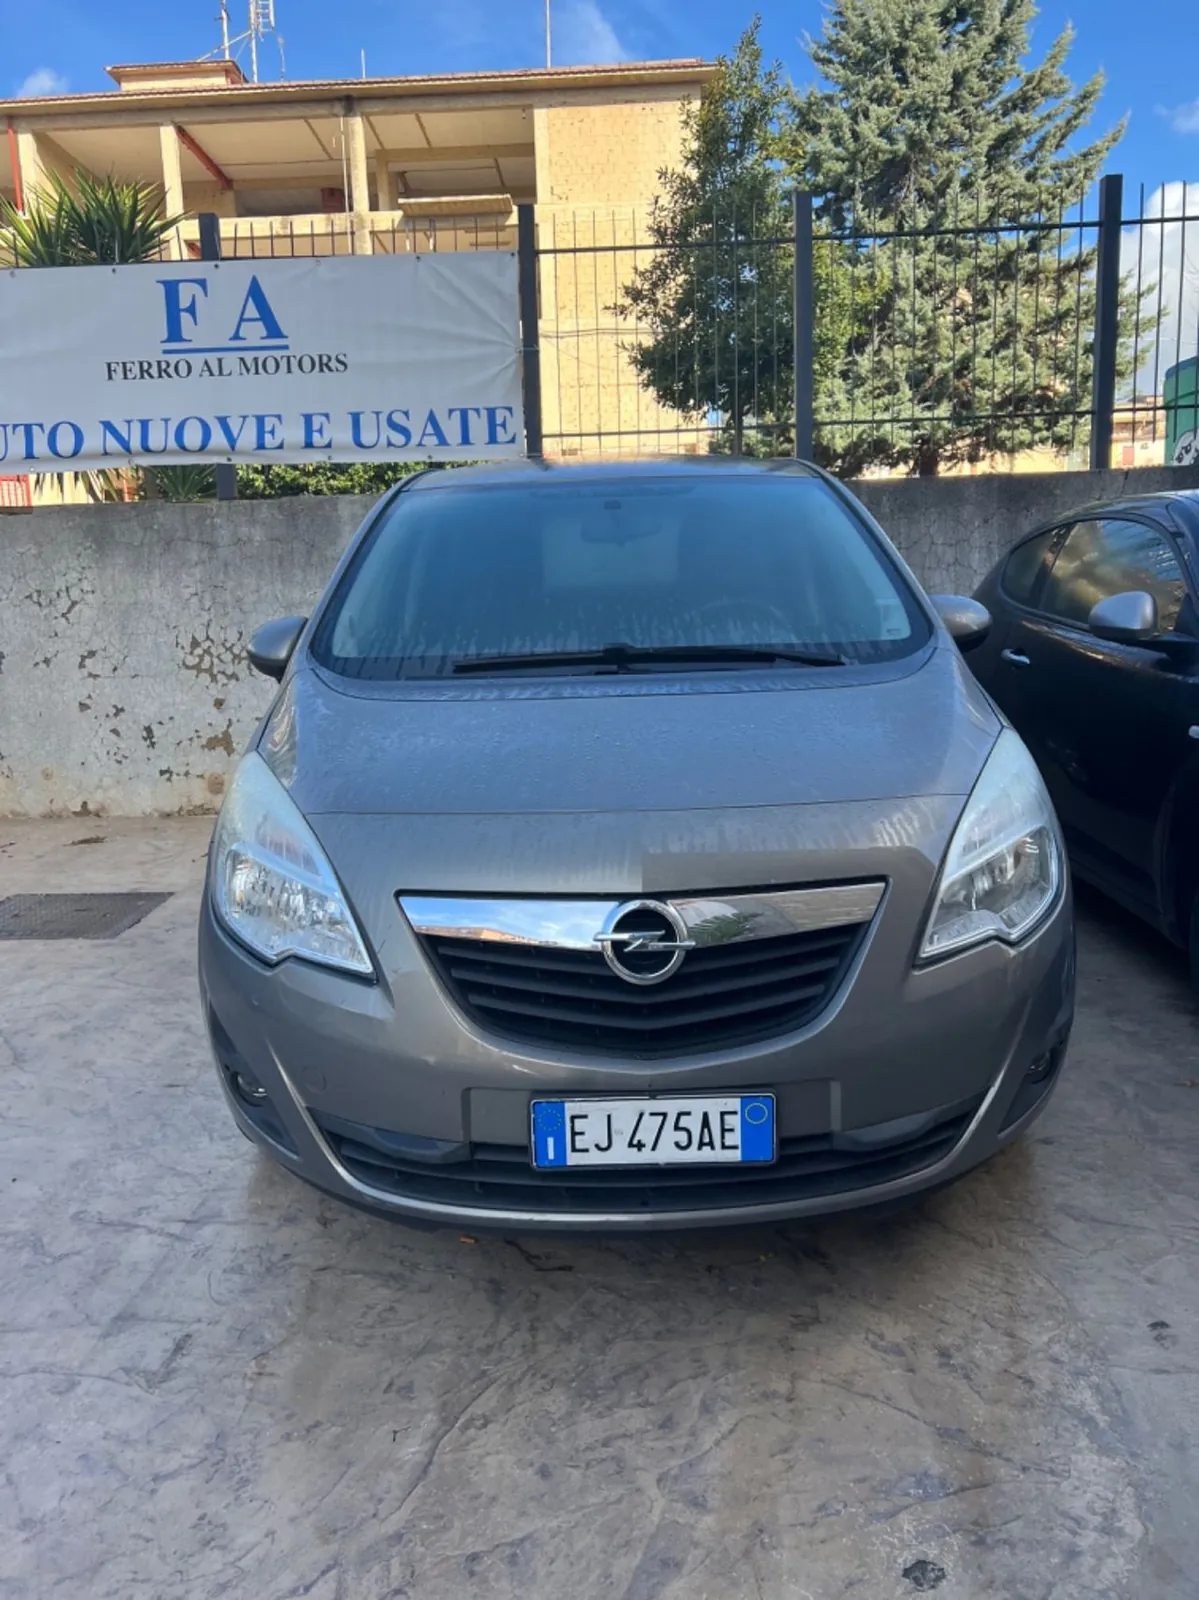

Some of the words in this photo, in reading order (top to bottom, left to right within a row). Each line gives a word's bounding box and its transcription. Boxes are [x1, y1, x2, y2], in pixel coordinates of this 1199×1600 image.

[105, 358, 193, 381] FERRO
[199, 357, 232, 377] AL
[239, 353, 348, 376] MOTORS
[0, 421, 84, 461] TO
[99, 414, 284, 456] NUOVE
[302, 412, 332, 449] E
[348, 407, 516, 449] USATE
